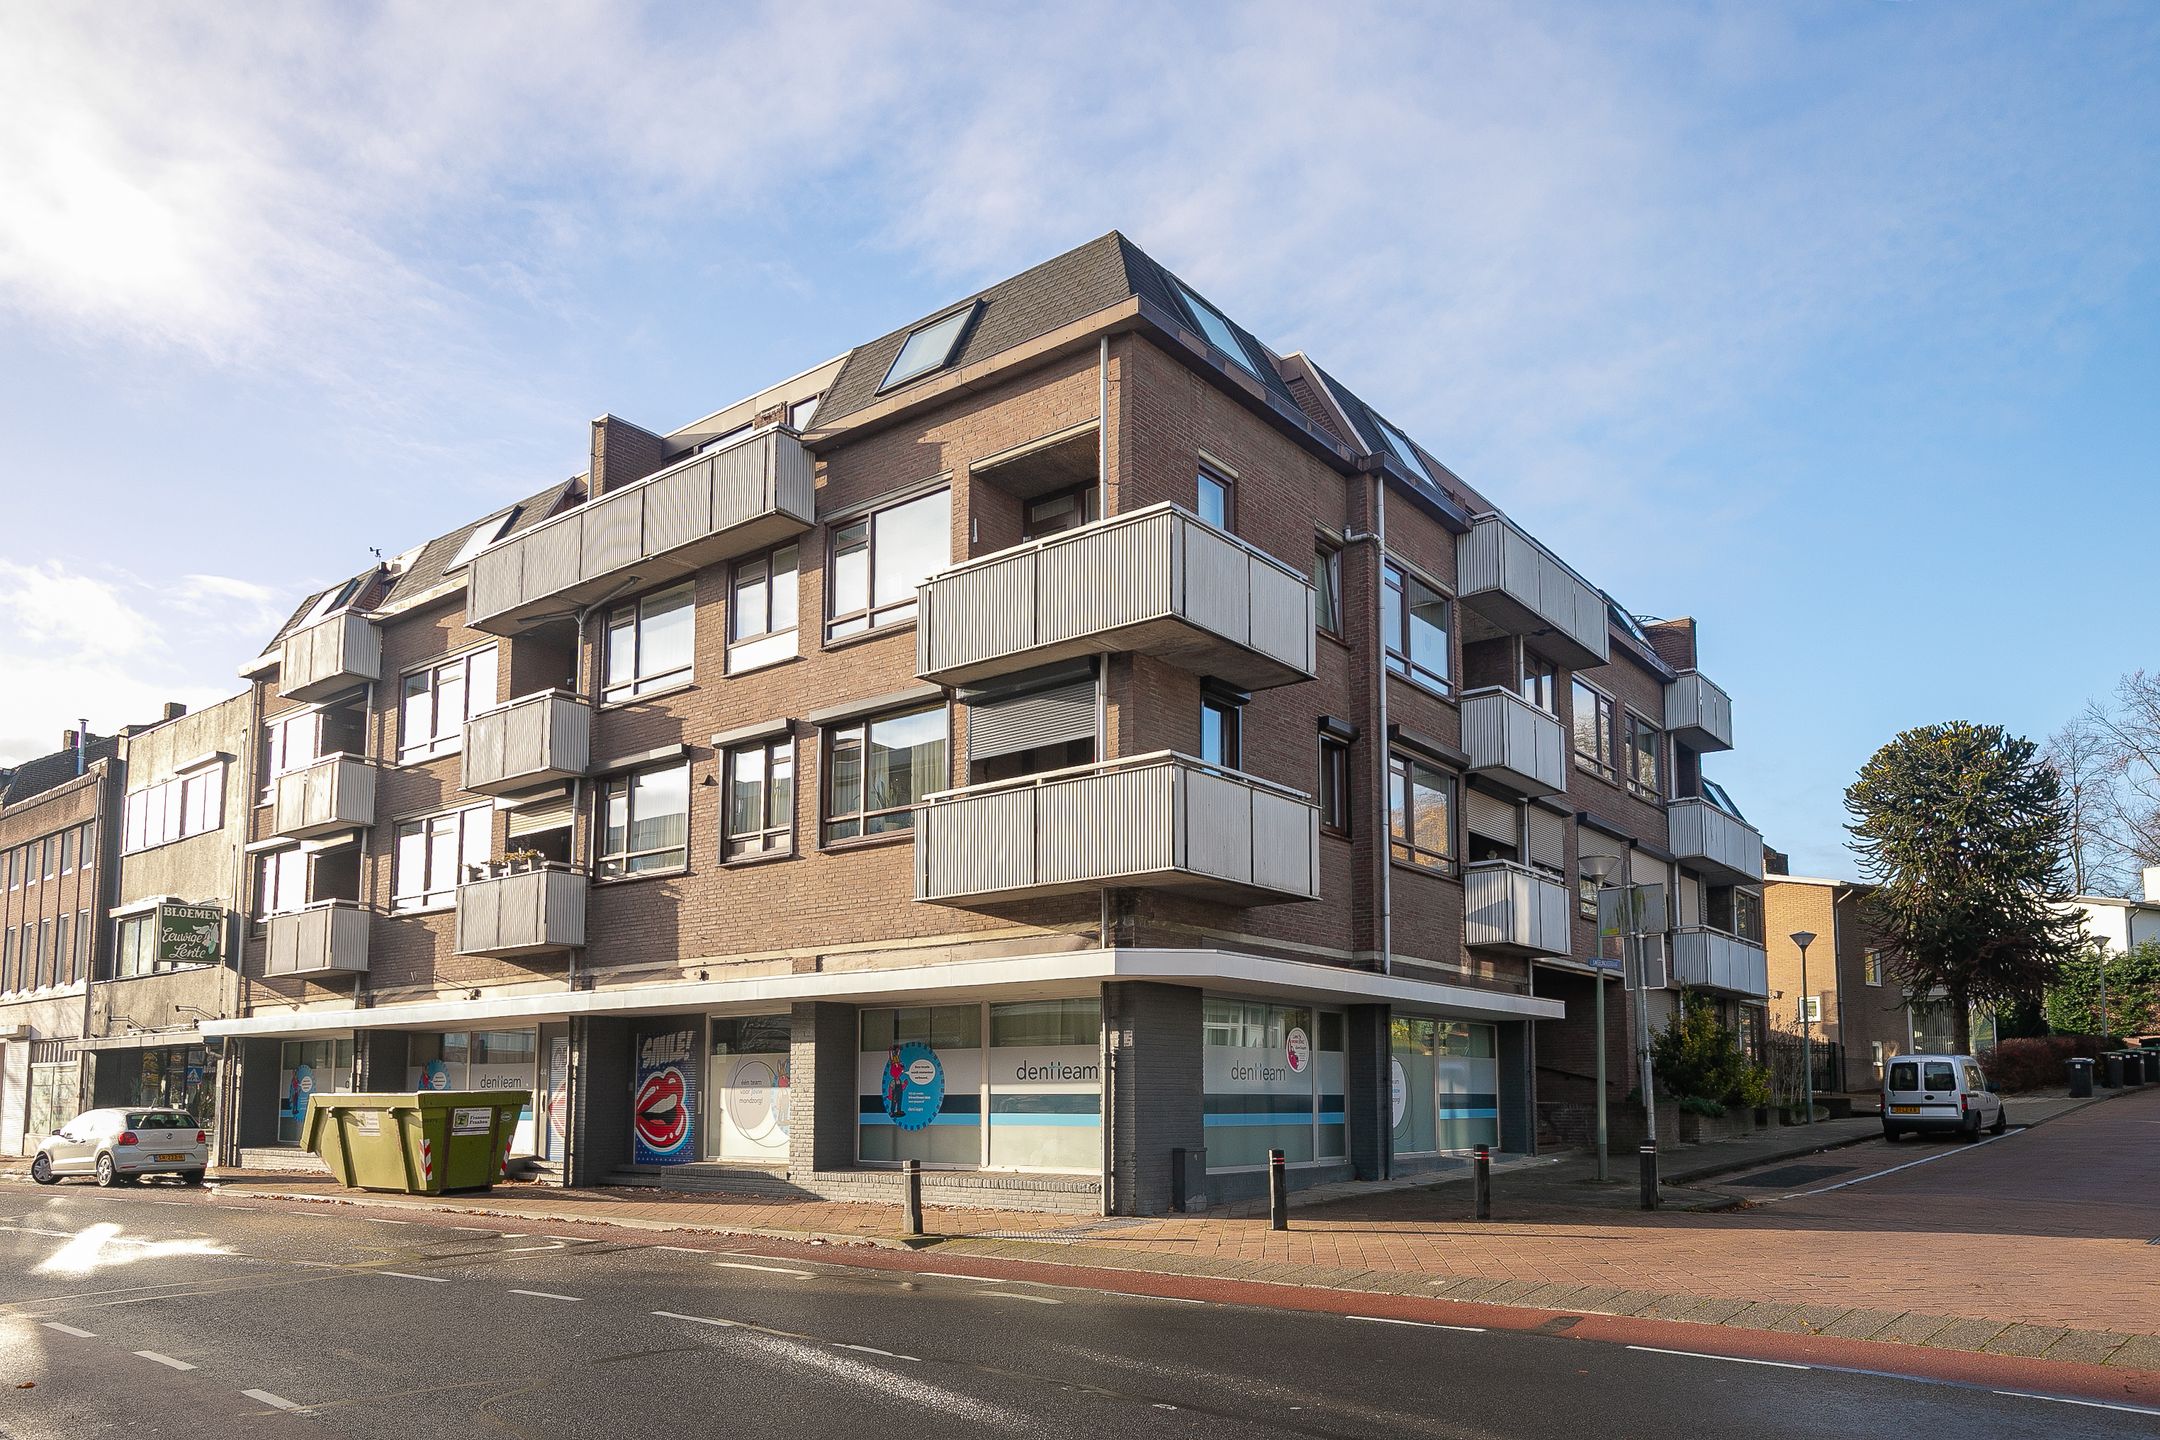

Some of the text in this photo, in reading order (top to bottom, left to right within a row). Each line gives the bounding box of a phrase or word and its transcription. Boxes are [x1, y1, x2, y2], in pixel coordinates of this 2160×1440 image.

[163, 906, 220, 920] BLOEMEN
[162, 926, 203, 947] Eeuwige
[169, 943, 206, 960] Lente
